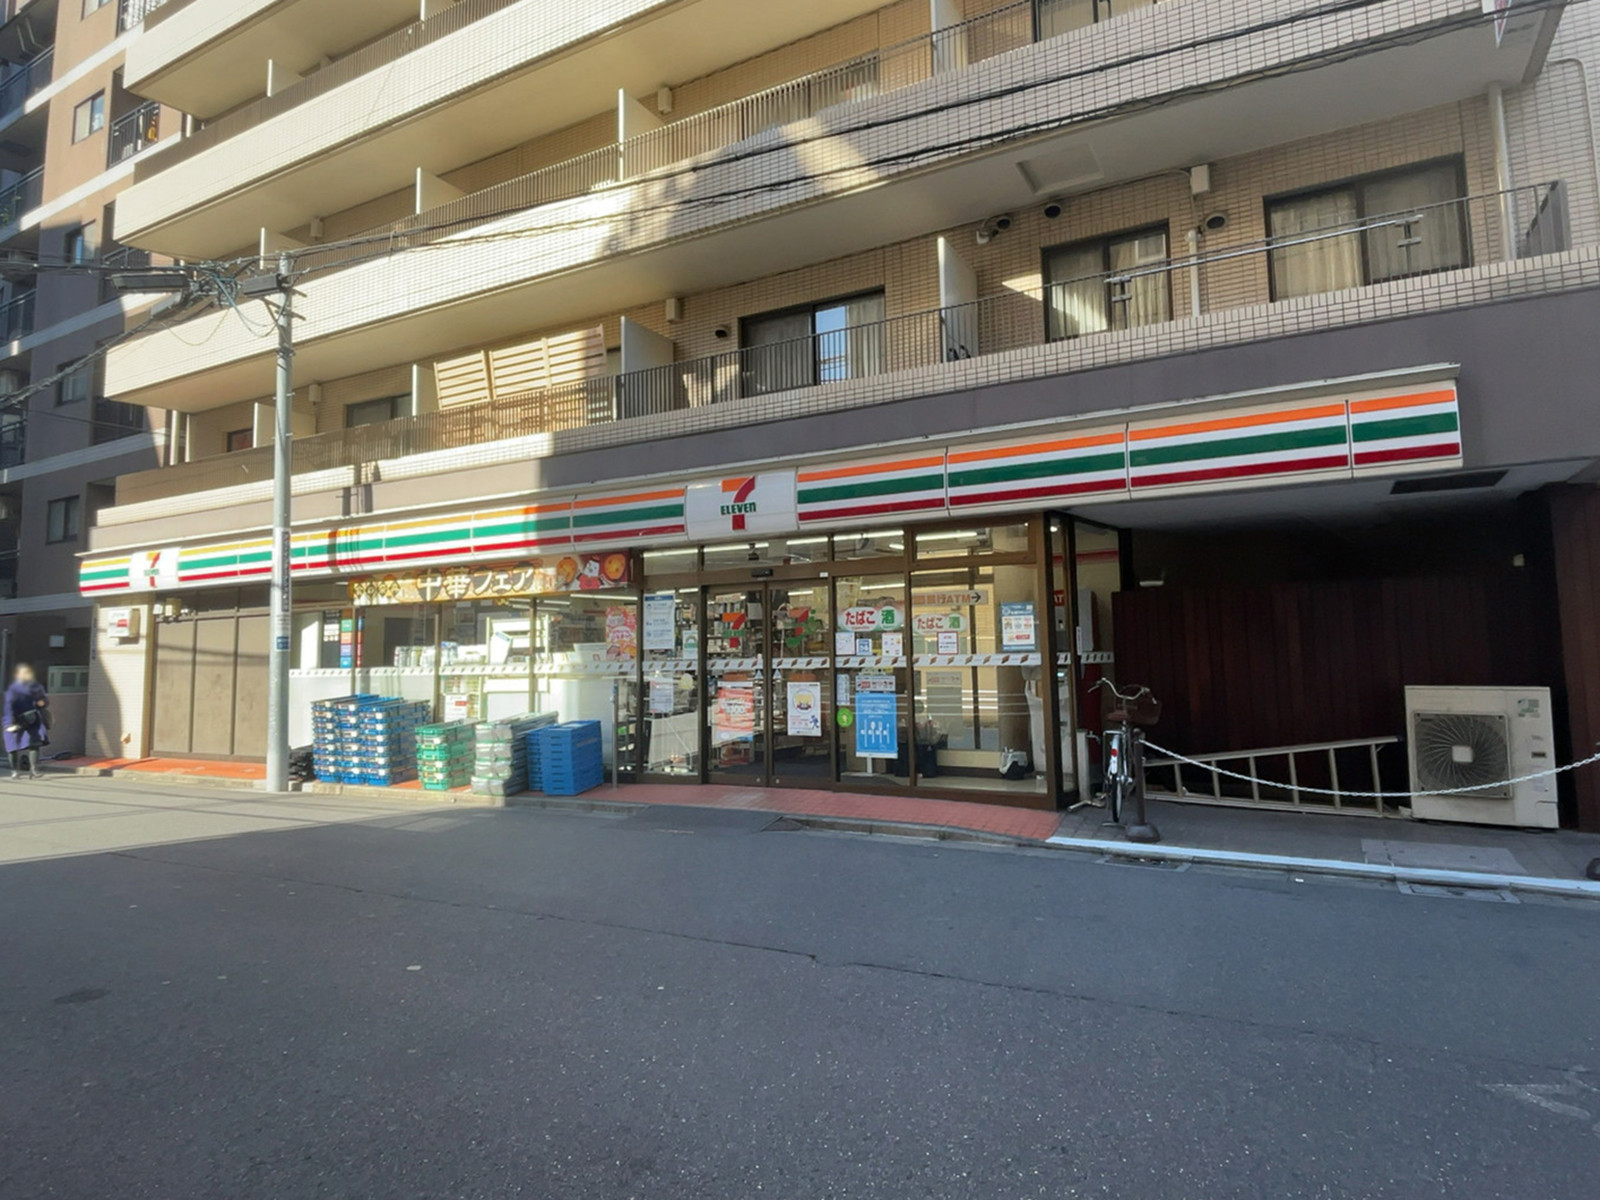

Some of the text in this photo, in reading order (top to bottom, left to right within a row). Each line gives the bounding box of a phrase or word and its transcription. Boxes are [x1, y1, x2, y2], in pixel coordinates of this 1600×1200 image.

[721, 476, 755, 531] 7
[146, 551, 161, 587] 7
[416, 564, 535, 602] 中華フェア
[845, 609, 895, 625] たばこ 酒
[917, 617, 944, 630] たばこ
